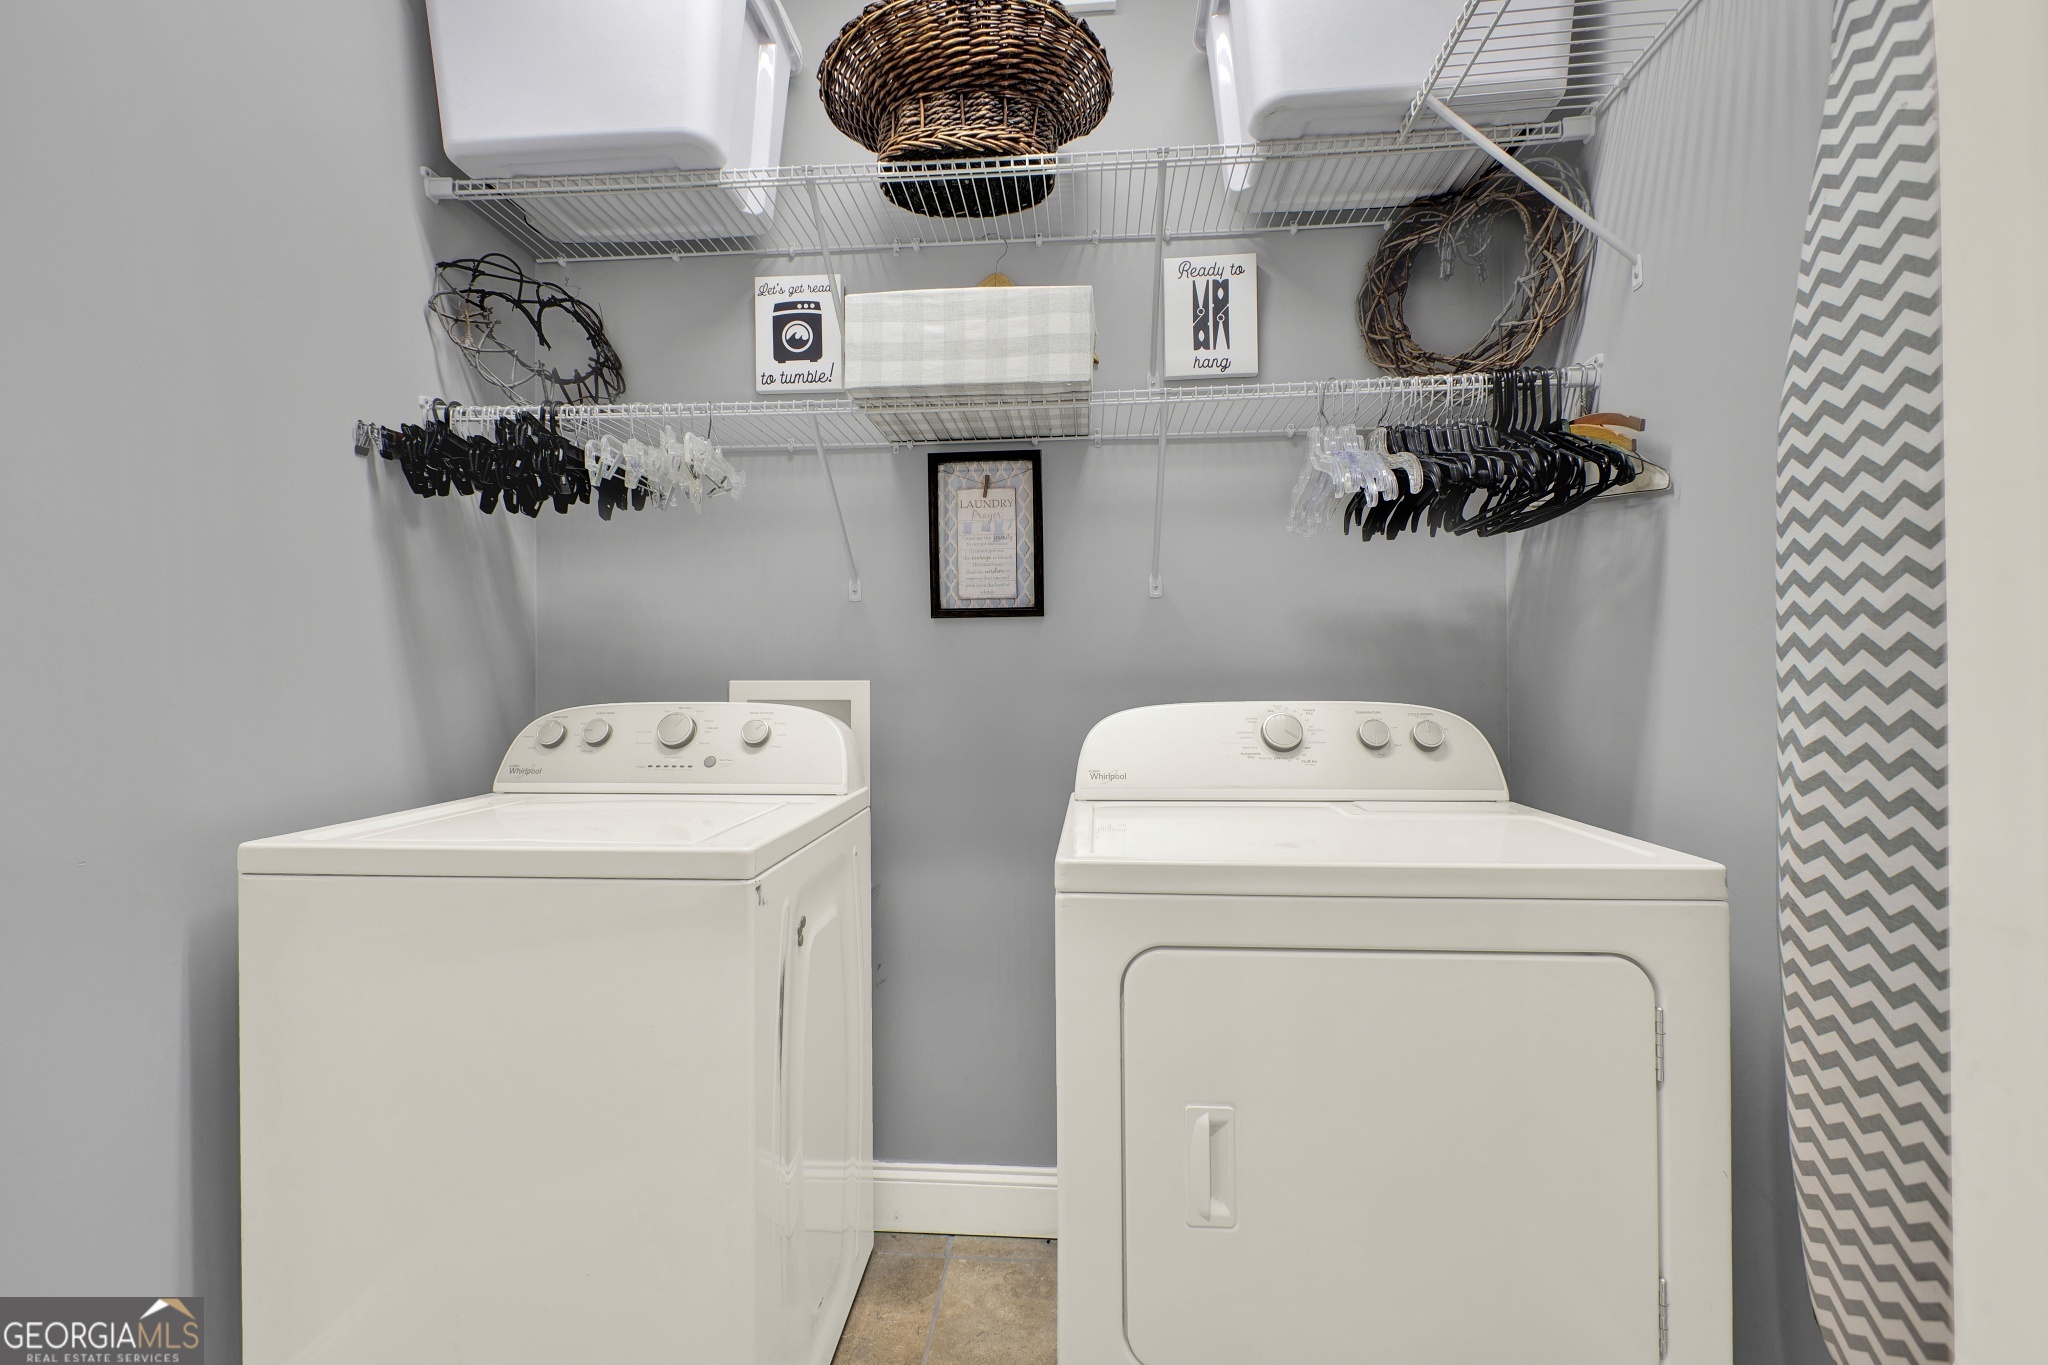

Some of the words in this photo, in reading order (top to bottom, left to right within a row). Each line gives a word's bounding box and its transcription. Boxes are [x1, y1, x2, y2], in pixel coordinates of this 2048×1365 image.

[1178, 260, 1225, 279] Ready
[1230, 263, 1246, 276] to
[757, 282, 786, 297] Let's
[788, 284, 804, 297] get
[1193, 356, 1231, 372] hang
[761, 372, 776, 385] to
[780, 362, 835, 385] tumble!
[960, 498, 1014, 509] LAUNDRY
[972, 509, 1003, 523] Prayer
[509, 767, 543, 777] Whirlpool
[1089, 772, 1128, 782] Whirlpool
